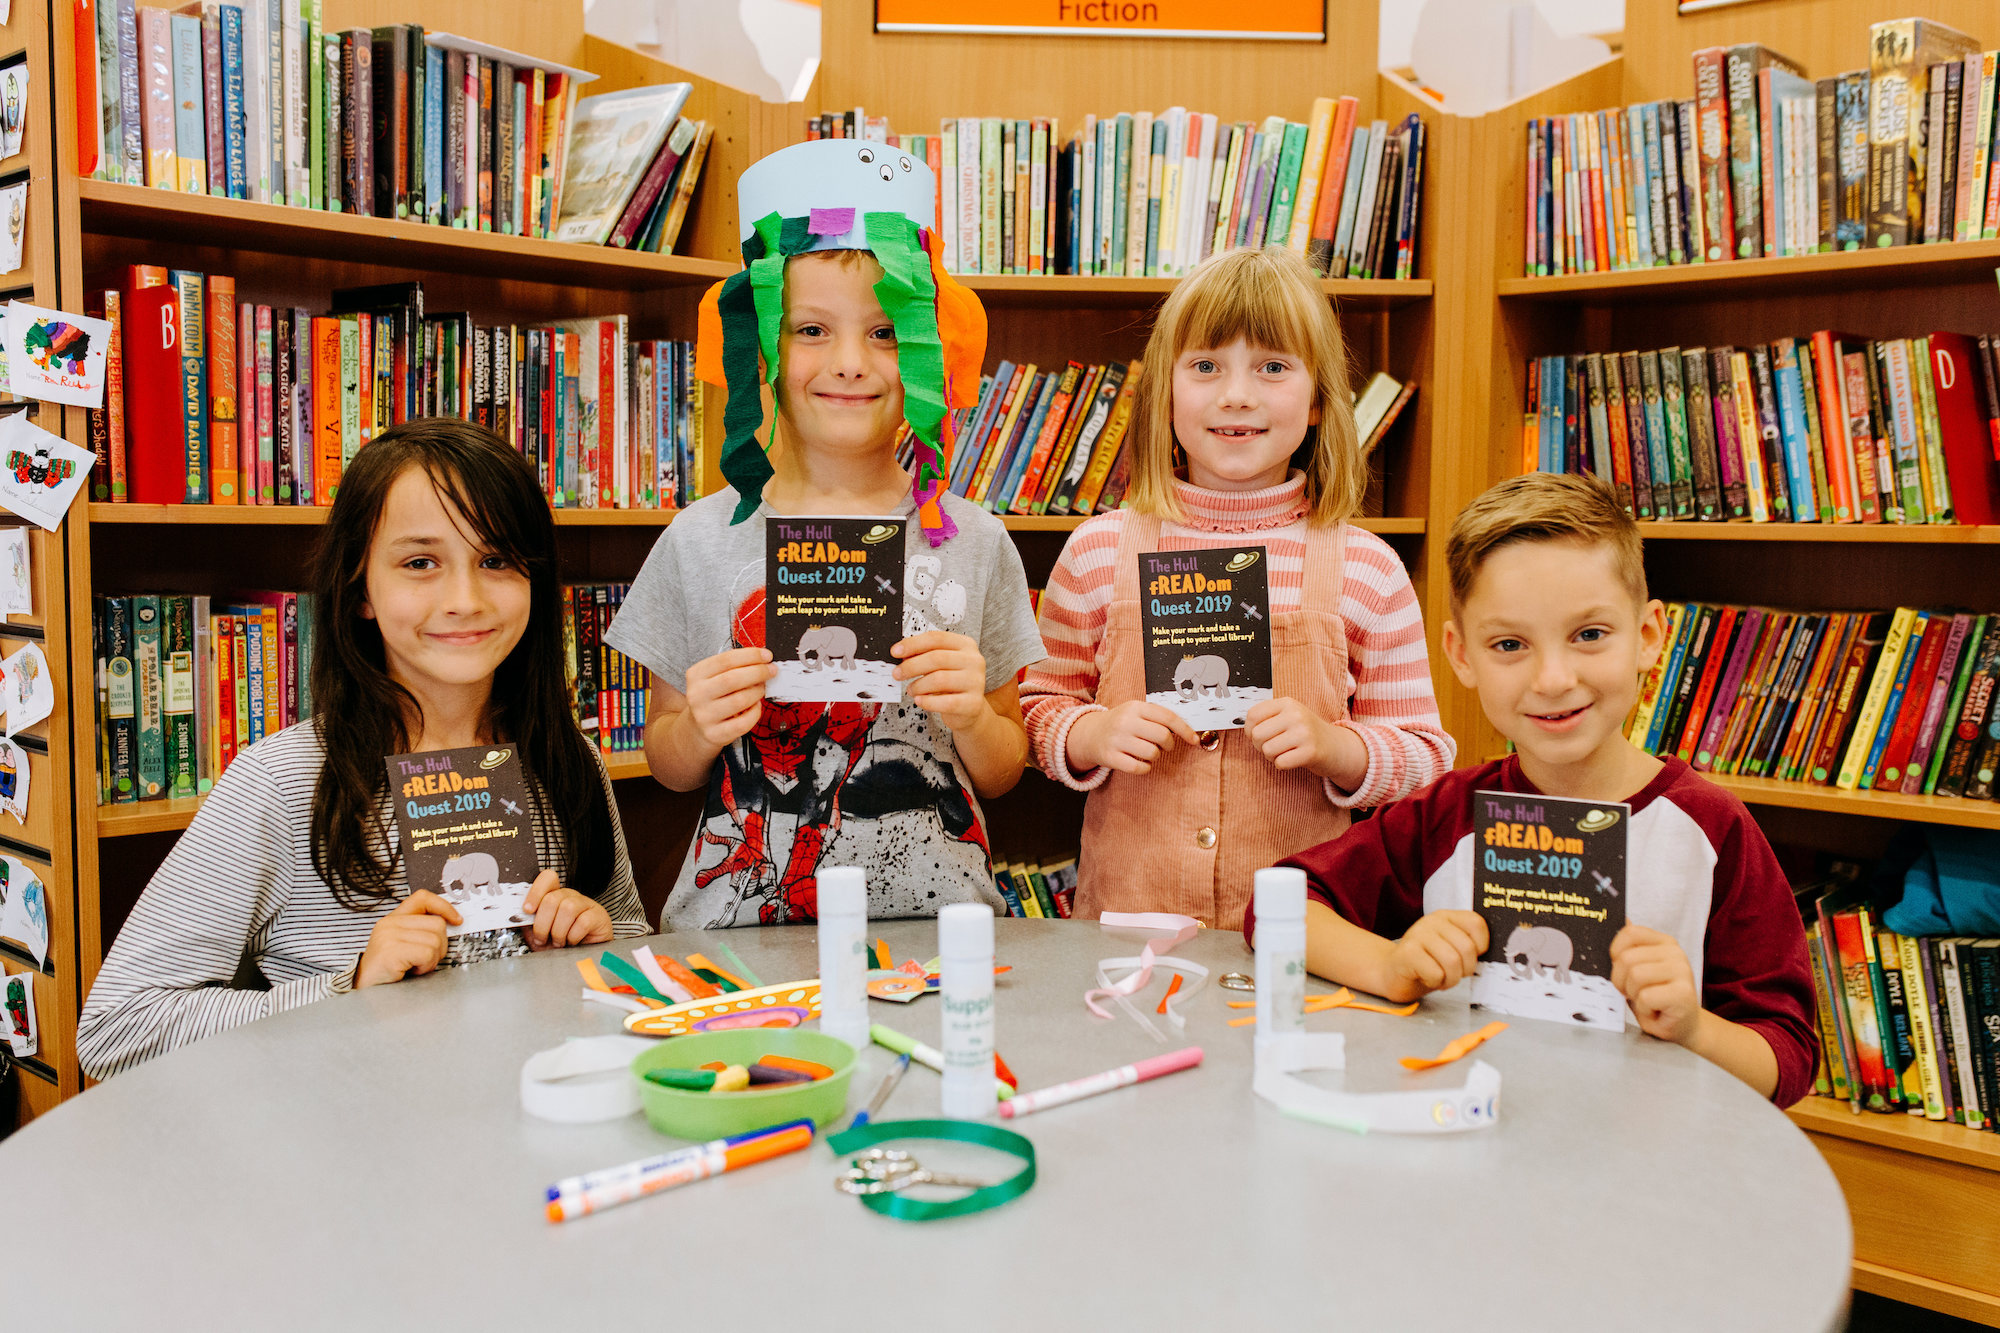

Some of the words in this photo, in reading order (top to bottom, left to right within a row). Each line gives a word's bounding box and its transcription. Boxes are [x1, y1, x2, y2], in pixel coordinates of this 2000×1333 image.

[227, 9, 238, 38] SCOTT
[1059, 0, 1158, 22] Fiction
[228, 41, 239, 68] ALLEN
[1697, 58, 1708, 110] COLFER
[1728, 55, 1742, 111] COLFER
[228, 75, 242, 129] LLAMAS
[1878, 80, 1893, 142] SECRETS
[1893, 81, 1906, 138] HOUSE
[1701, 110, 1721, 159] WARP
[231, 148, 243, 186] LARGE
[1960, 142, 1972, 188] TOWER
[962, 167, 975, 224] CHRISTMAS
[963, 227, 976, 262] TREATS
[216, 295, 232, 314] The
[160, 303, 176, 349] B
[110, 356, 122, 397] REBEL
[280, 351, 289, 413] MAGICAL
[474, 329, 484, 403] BARROWMAN
[495, 331, 504, 406] BARROWMAN
[1891, 346, 1905, 399] GILLIAN
[1935, 349, 1955, 390] D
[187, 375, 200, 416] DAVID
[281, 415, 290, 451] MAIL
[1897, 402, 1911, 442] CROSS
[566, 432, 577, 460] FIRE
[1071, 411, 1107, 476] COGHEART
[777, 525, 802, 539] The
[806, 525, 832, 539] Hull
[777, 542, 867, 563] fREADom
[1148, 559, 1170, 573] The
[1173, 557, 1198, 571] Hull
[778, 566, 822, 584] Quest
[826, 566, 865, 584] 2019
[1149, 573, 1232, 595] fREADom
[777, 595, 797, 604] Make
[798, 597, 815, 608] your
[816, 595, 834, 604] mark
[836, 595, 849, 604] and
[850, 595, 866, 604] take
[777, 605, 796, 616] giant
[798, 605, 813, 616] leap
[814, 606, 822, 614] to
[823, 607, 840, 616] your
[841, 605, 858, 614] local
[859, 605, 887, 616] library!
[1151, 599, 1192, 617] Quest
[1195, 595, 1232, 614] 2019
[1153, 627, 1170, 635] Make
[1171, 627, 1186, 638] your
[1188, 625, 1204, 634] mark
[1206, 624, 1218, 632] and
[1219, 623, 1233, 632] take
[1153, 636, 1170, 647] giant
[1171, 635, 1185, 646] leap
[1186, 636, 1194, 644] to
[1194, 636, 1210, 646] your
[1212, 633, 1227, 642] local
[1228, 632, 1255, 643] library!
[249, 632, 260, 672] PUDDING
[265, 636, 276, 673] STINKY
[148, 656, 158, 692] POLAR
[150, 695, 159, 725] BEAR
[251, 674, 263, 717] PROBLEM
[266, 680, 279, 717] TRUTH
[1974, 676, 1995, 724] SECRET
[118, 727, 128, 766] JENNIFER
[178, 722, 188, 760] JENNIFER
[398, 761, 423, 775] The
[425, 756, 452, 772] Hull
[403, 772, 489, 798] fREADom
[407, 800, 452, 819] Quest
[454, 792, 491, 812] 2019
[1485, 801, 1512, 820] The
[1515, 804, 1544, 823] Hull
[411, 828, 431, 838] Make
[432, 827, 448, 839] your
[450, 823, 467, 833] mark
[469, 821, 481, 831] and
[482, 820, 497, 830] take
[413, 837, 433, 851] giant
[434, 836, 449, 847] leap
[450, 835, 458, 843] to
[458, 833, 475, 845] your
[475, 830, 492, 840] local
[492, 827, 518, 839] library!
[1484, 822, 1584, 854] fREADom
[1484, 850, 1534, 874] Quest
[1537, 854, 1582, 879] 2019
[1484, 883, 1505, 896] Make
[1506, 888, 1526, 900] your
[1526, 888, 1548, 901] mark
[1548, 890, 1564, 902] and
[1564, 892, 1582, 904] take
[1583, 896, 1590, 905] a
[1484, 896, 1505, 909] giant
[1506, 898, 1524, 912] leap
[1524, 901, 1534, 910] to
[1534, 902, 1554, 914] your
[1554, 904, 1574, 916] local
[1575, 906, 1608, 922] library!
[1886, 971, 1904, 1006] DOYLE
[1908, 974, 1922, 1008] DOYLE
